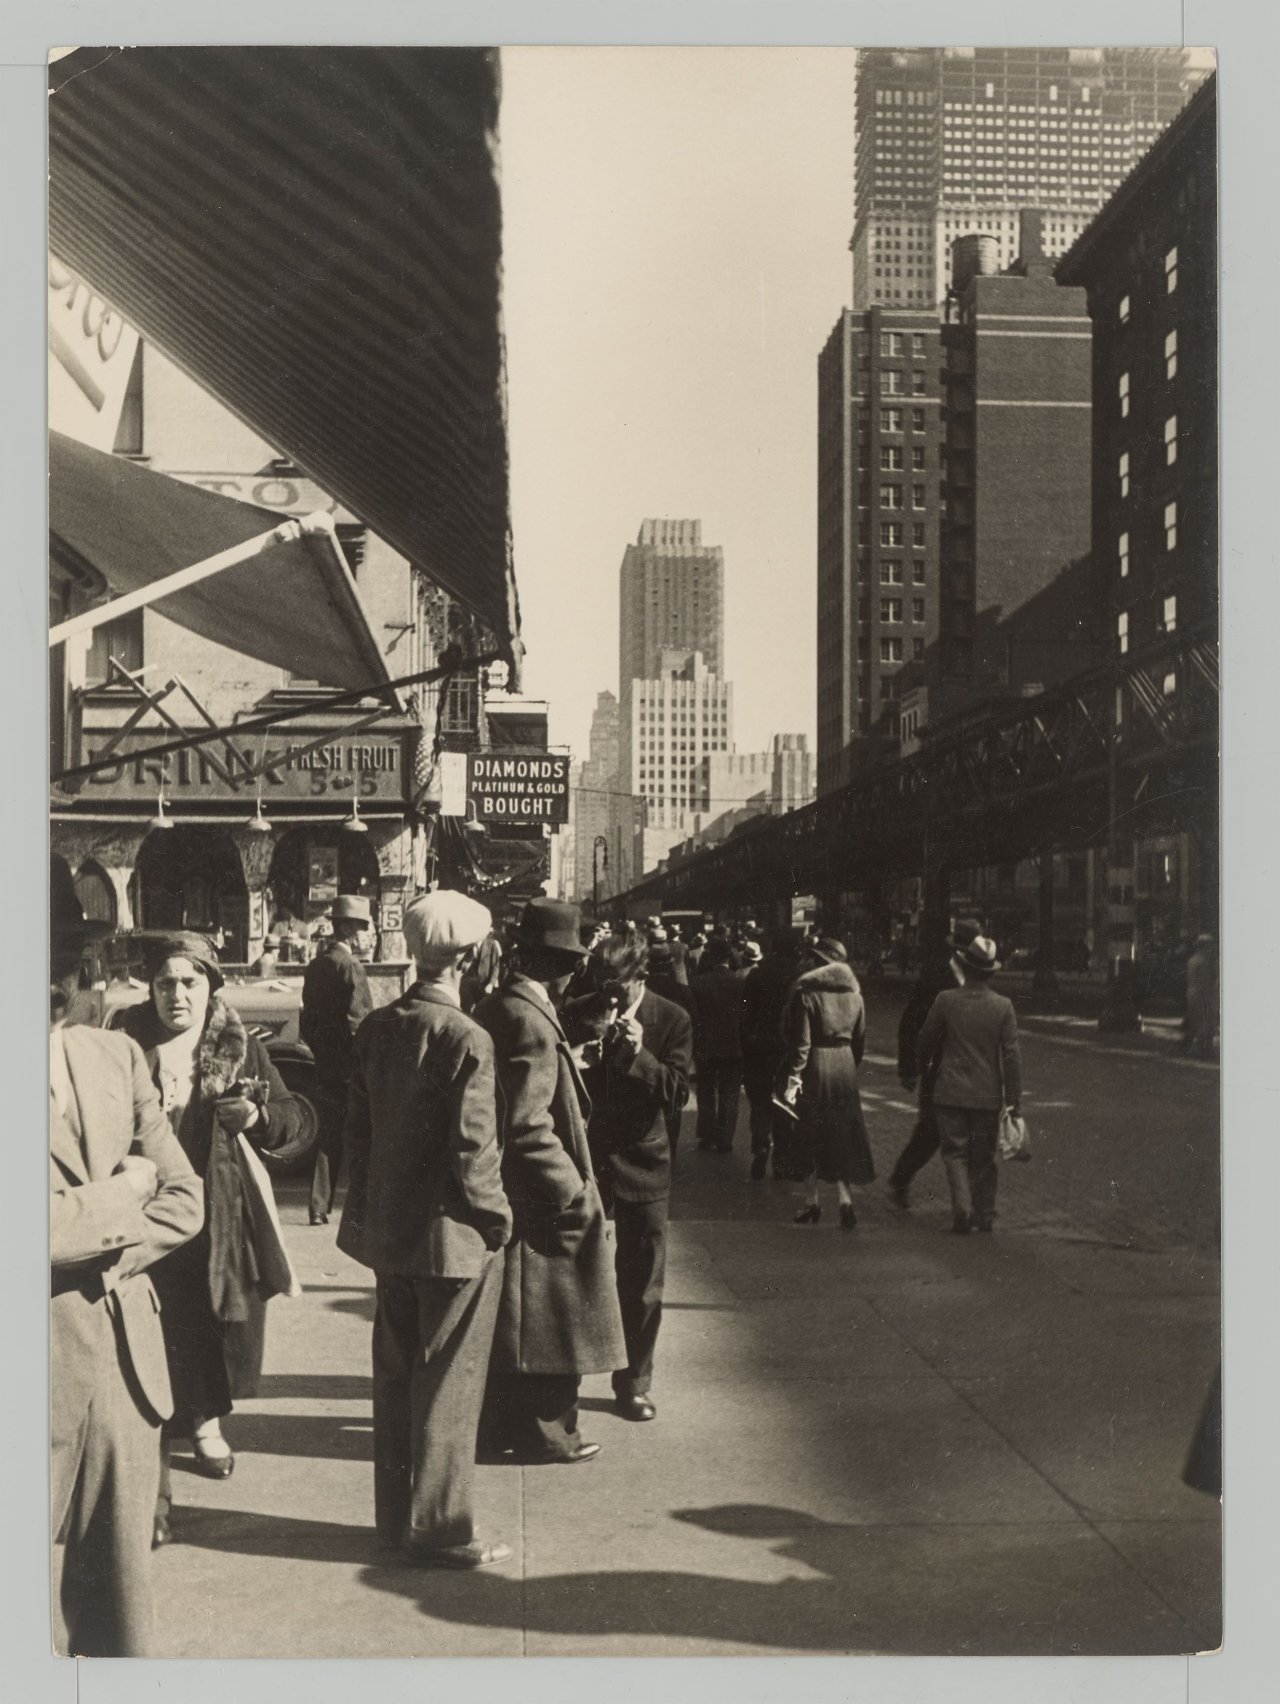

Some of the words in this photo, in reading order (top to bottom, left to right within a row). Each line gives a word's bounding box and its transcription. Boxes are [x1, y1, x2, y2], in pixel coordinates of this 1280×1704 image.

[288, 744, 344, 770] FRESH
[350, 744, 400, 771] FRUIT
[87, 748, 285, 786] DRINK
[473, 760, 564, 778] DIAMONDS
[360, 768, 378, 796] 5
[471, 781, 525, 794] PLATINUM
[527, 782, 536, 794] &
[536, 783, 565, 795] GOLD
[483, 797, 554, 815] BOUGHT
[385, 910, 400, 928] 5
